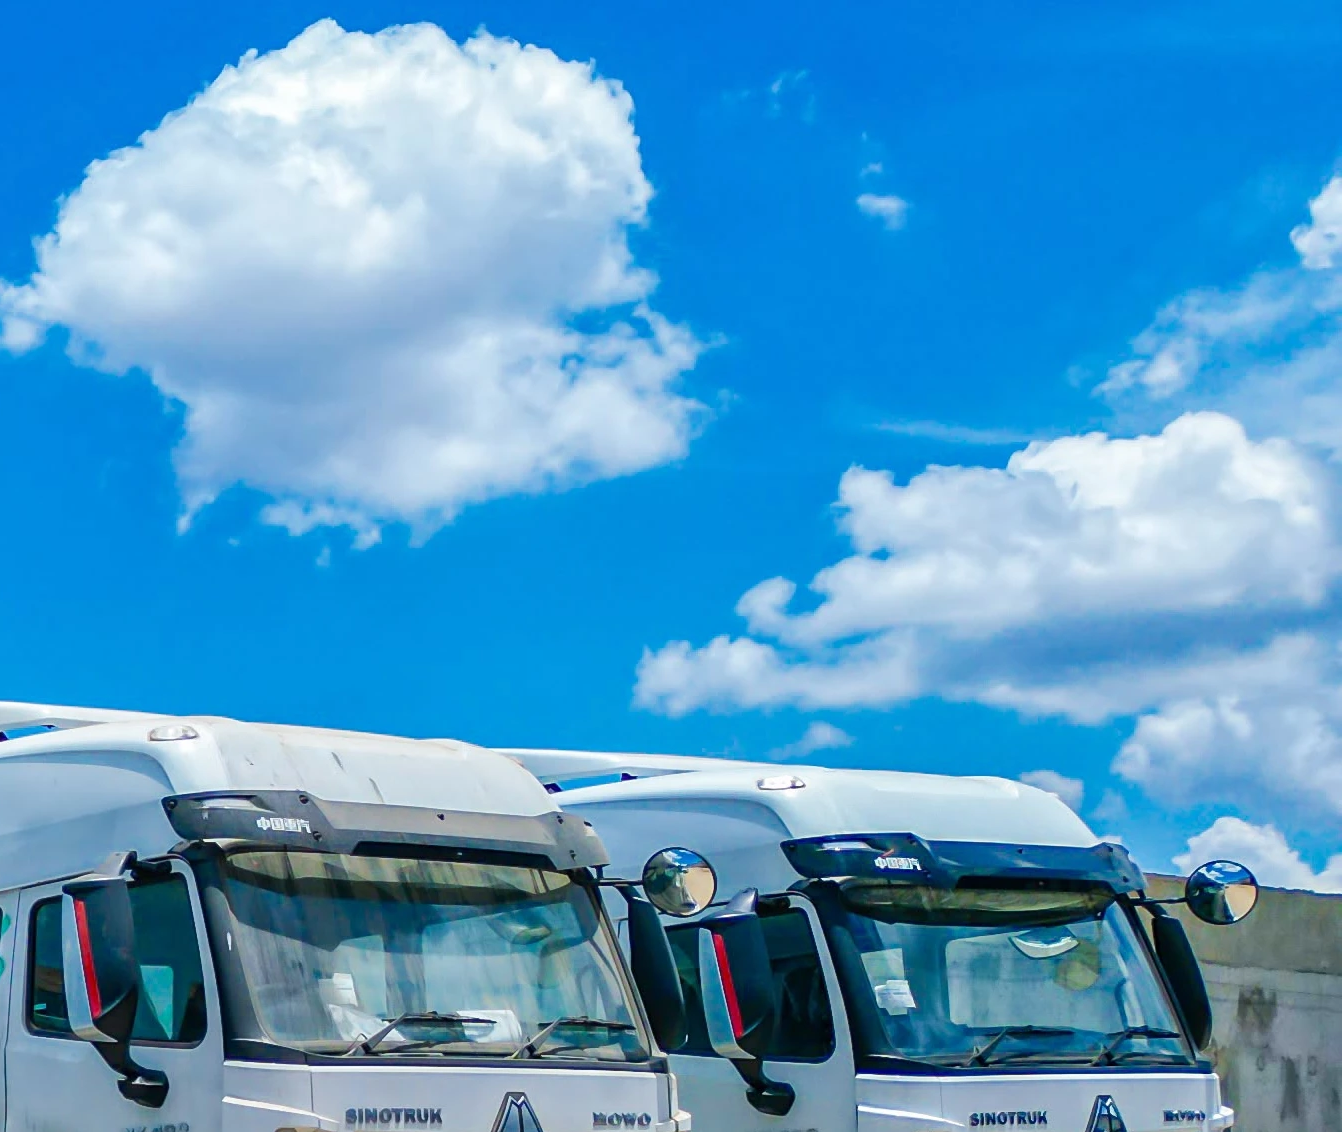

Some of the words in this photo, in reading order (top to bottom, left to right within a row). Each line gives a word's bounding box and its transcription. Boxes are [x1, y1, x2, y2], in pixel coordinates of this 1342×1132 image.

[344, 1107, 443, 1125] SINOTRUK
[592, 1111, 652, 1127] HOWO
[969, 1110, 1048, 1127] SINOTRUK
